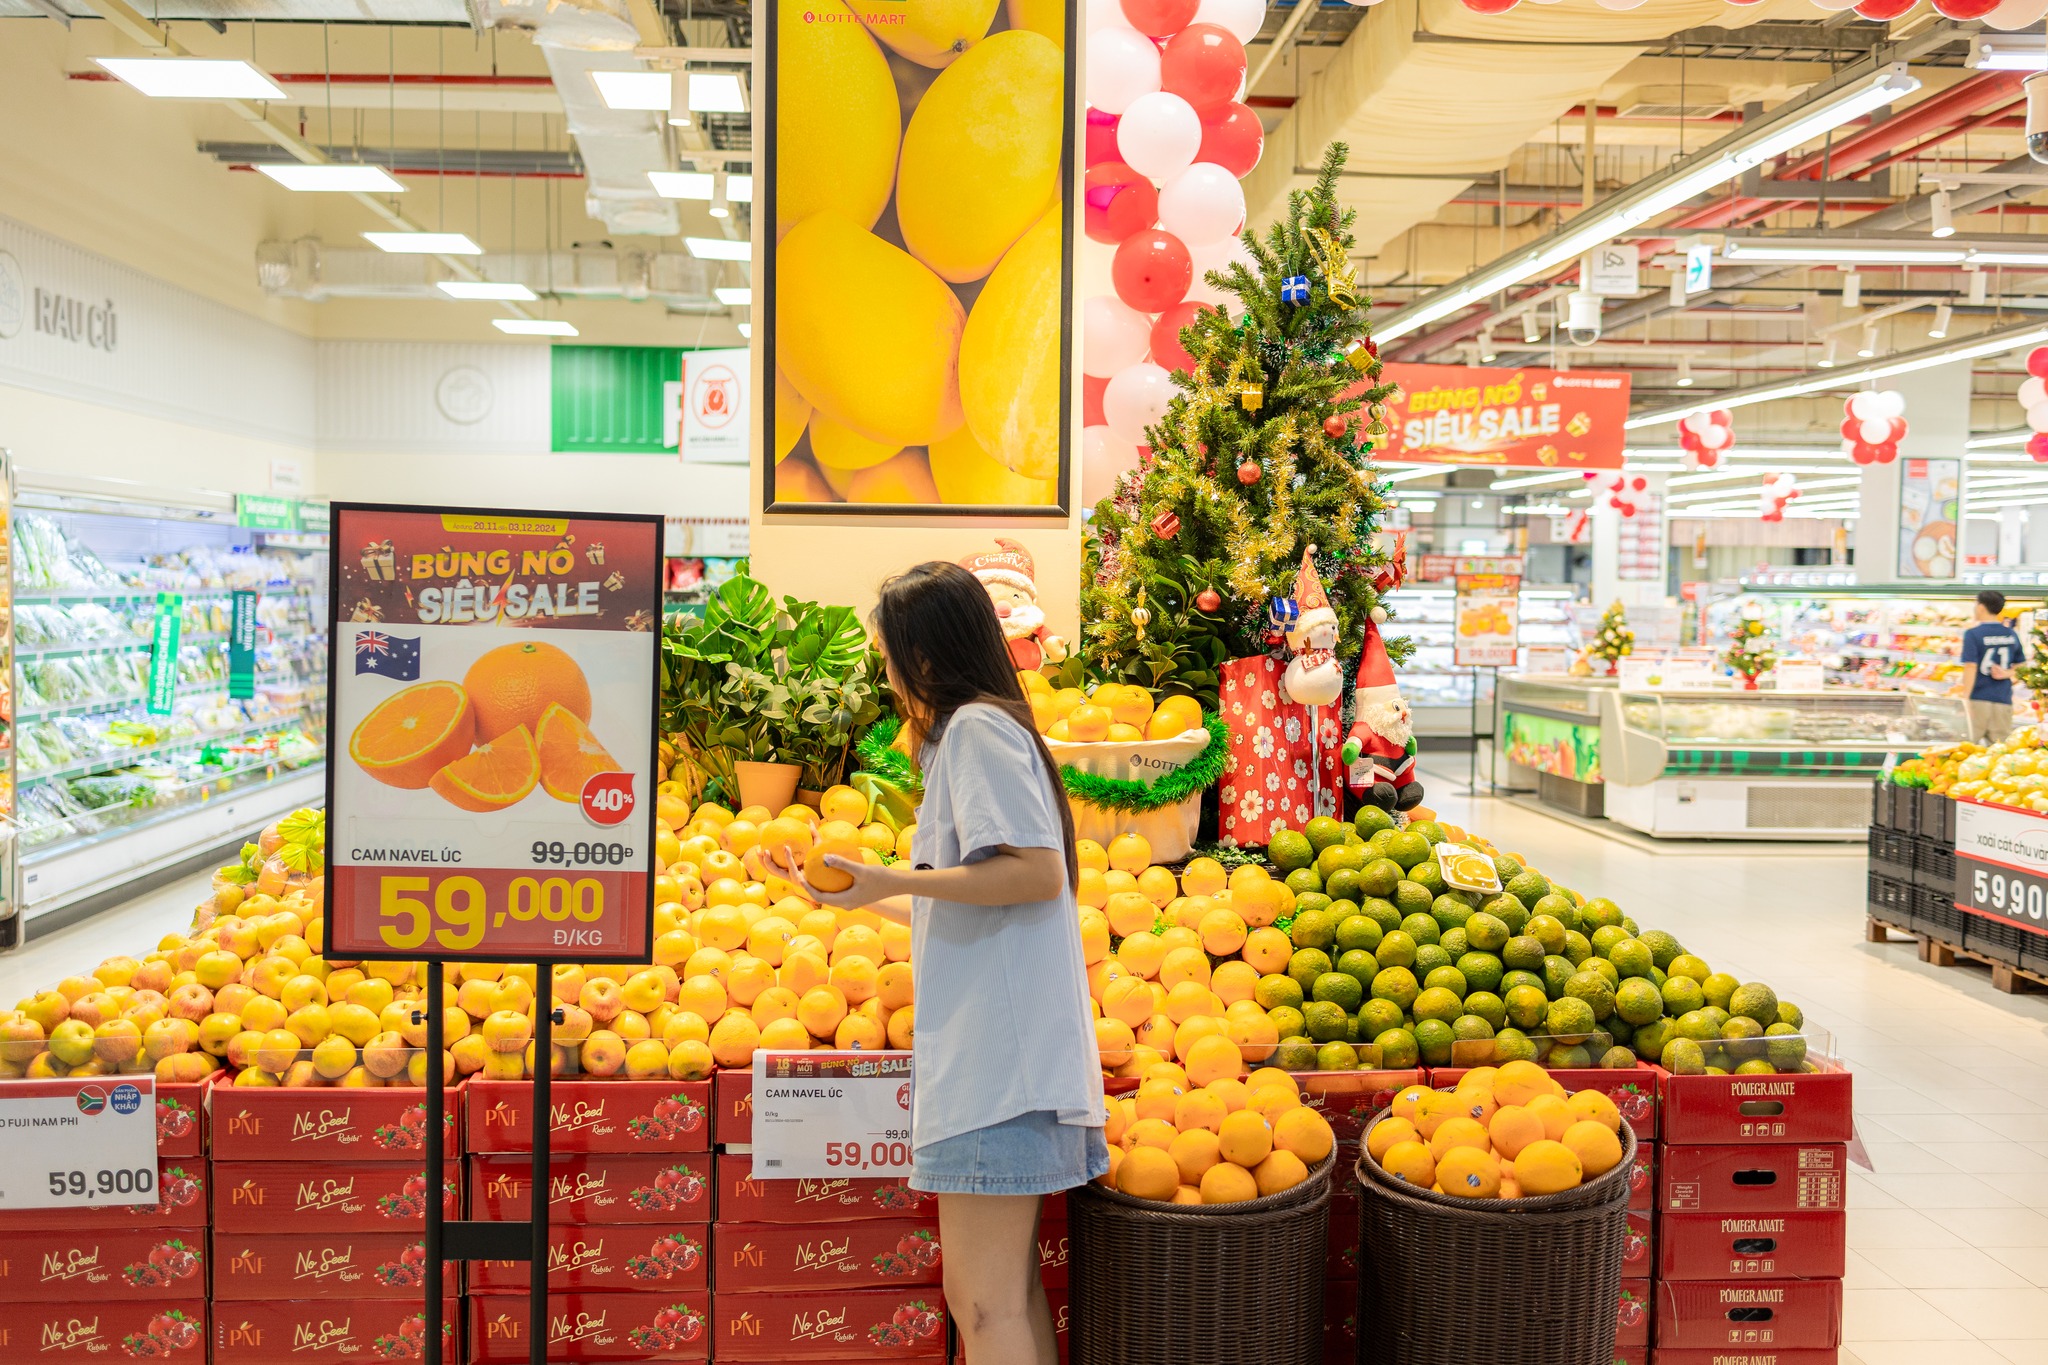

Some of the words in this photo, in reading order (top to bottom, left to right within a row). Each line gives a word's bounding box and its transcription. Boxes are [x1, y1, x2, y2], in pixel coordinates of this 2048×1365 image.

[818, 13, 862, 24] LOTTE
[866, 13, 907, 25] MART
[34, 286, 84, 343] RAU
[1408, 385, 1480, 414] BÙNG
[1403, 409, 1471, 449] SIÊU
[1479, 403, 1561, 440] SALE
[411, 545, 510, 580] BÙNG
[521, 535, 576, 576] NỔ
[417, 578, 500, 623] SIÊU
[504, 581, 600, 620] SALE
[351, 849, 386, 862] CAM
[389, 849, 438, 863] NAVEL
[440, 846, 462, 863] ÚC
[1997, 834, 2013, 852] cát
[2013, 839, 2032, 857] chu
[1974, 868, 2048, 921] 59,90
[378, 875, 604, 950] 59,000
[553, 929, 603, 947] Đ/KG
[820, 1058, 845, 1070] BÙNG
[851, 1058, 880, 1077] SIÊU
[765, 1089, 790, 1098] CAM
[792, 1089, 826, 1098] NAVEL
[828, 1086, 843, 1098] ÚC
[8, 1118, 30, 1128] FUJI
[32, 1117, 58, 1127] NAM
[60, 1116, 79, 1126] PHI
[229, 1117, 264, 1135] PNF
[293, 1111, 315, 1136] No
[318, 1106, 351, 1134] Seed
[485, 1109, 520, 1127] PNF
[550, 1102, 570, 1127] No
[573, 1098, 605, 1125] Seed
[885, 1129, 910, 1141] 99,0
[49, 1168, 153, 1199] 59,900
[232, 1187, 267, 1205] PNF
[297, 1180, 319, 1205] No
[321, 1176, 354, 1203] Seed
[488, 1181, 522, 1199] PNF
[551, 1174, 572, 1199] No
[575, 1169, 607, 1196] Seed
[735, 1180, 768, 1198] PNF
[42, 1251, 64, 1276] No
[67, 1245, 99, 1273] Seed
[231, 1256, 266, 1274] PNF
[295, 1249, 317, 1274] No
[320, 1245, 352, 1272] Seed
[548, 1243, 569, 1268] No
[572, 1238, 603, 1265] Seed
[734, 1250, 767, 1268] PNF
[796, 1242, 816, 1266] No
[819, 1236, 850, 1263] Seed
[42, 1321, 63, 1346] No
[67, 1316, 99, 1343] Seed
[294, 1321, 316, 1346] No
[318, 1317, 351, 1344] Seed
[487, 1321, 522, 1339] PNF
[551, 1314, 572, 1338] No
[574, 1309, 606, 1336] Seed
[731, 1318, 764, 1336] PNF
[792, 1311, 813, 1336] No
[816, 1306, 846, 1333] Seed
[230, 1328, 264, 1346] PNF
